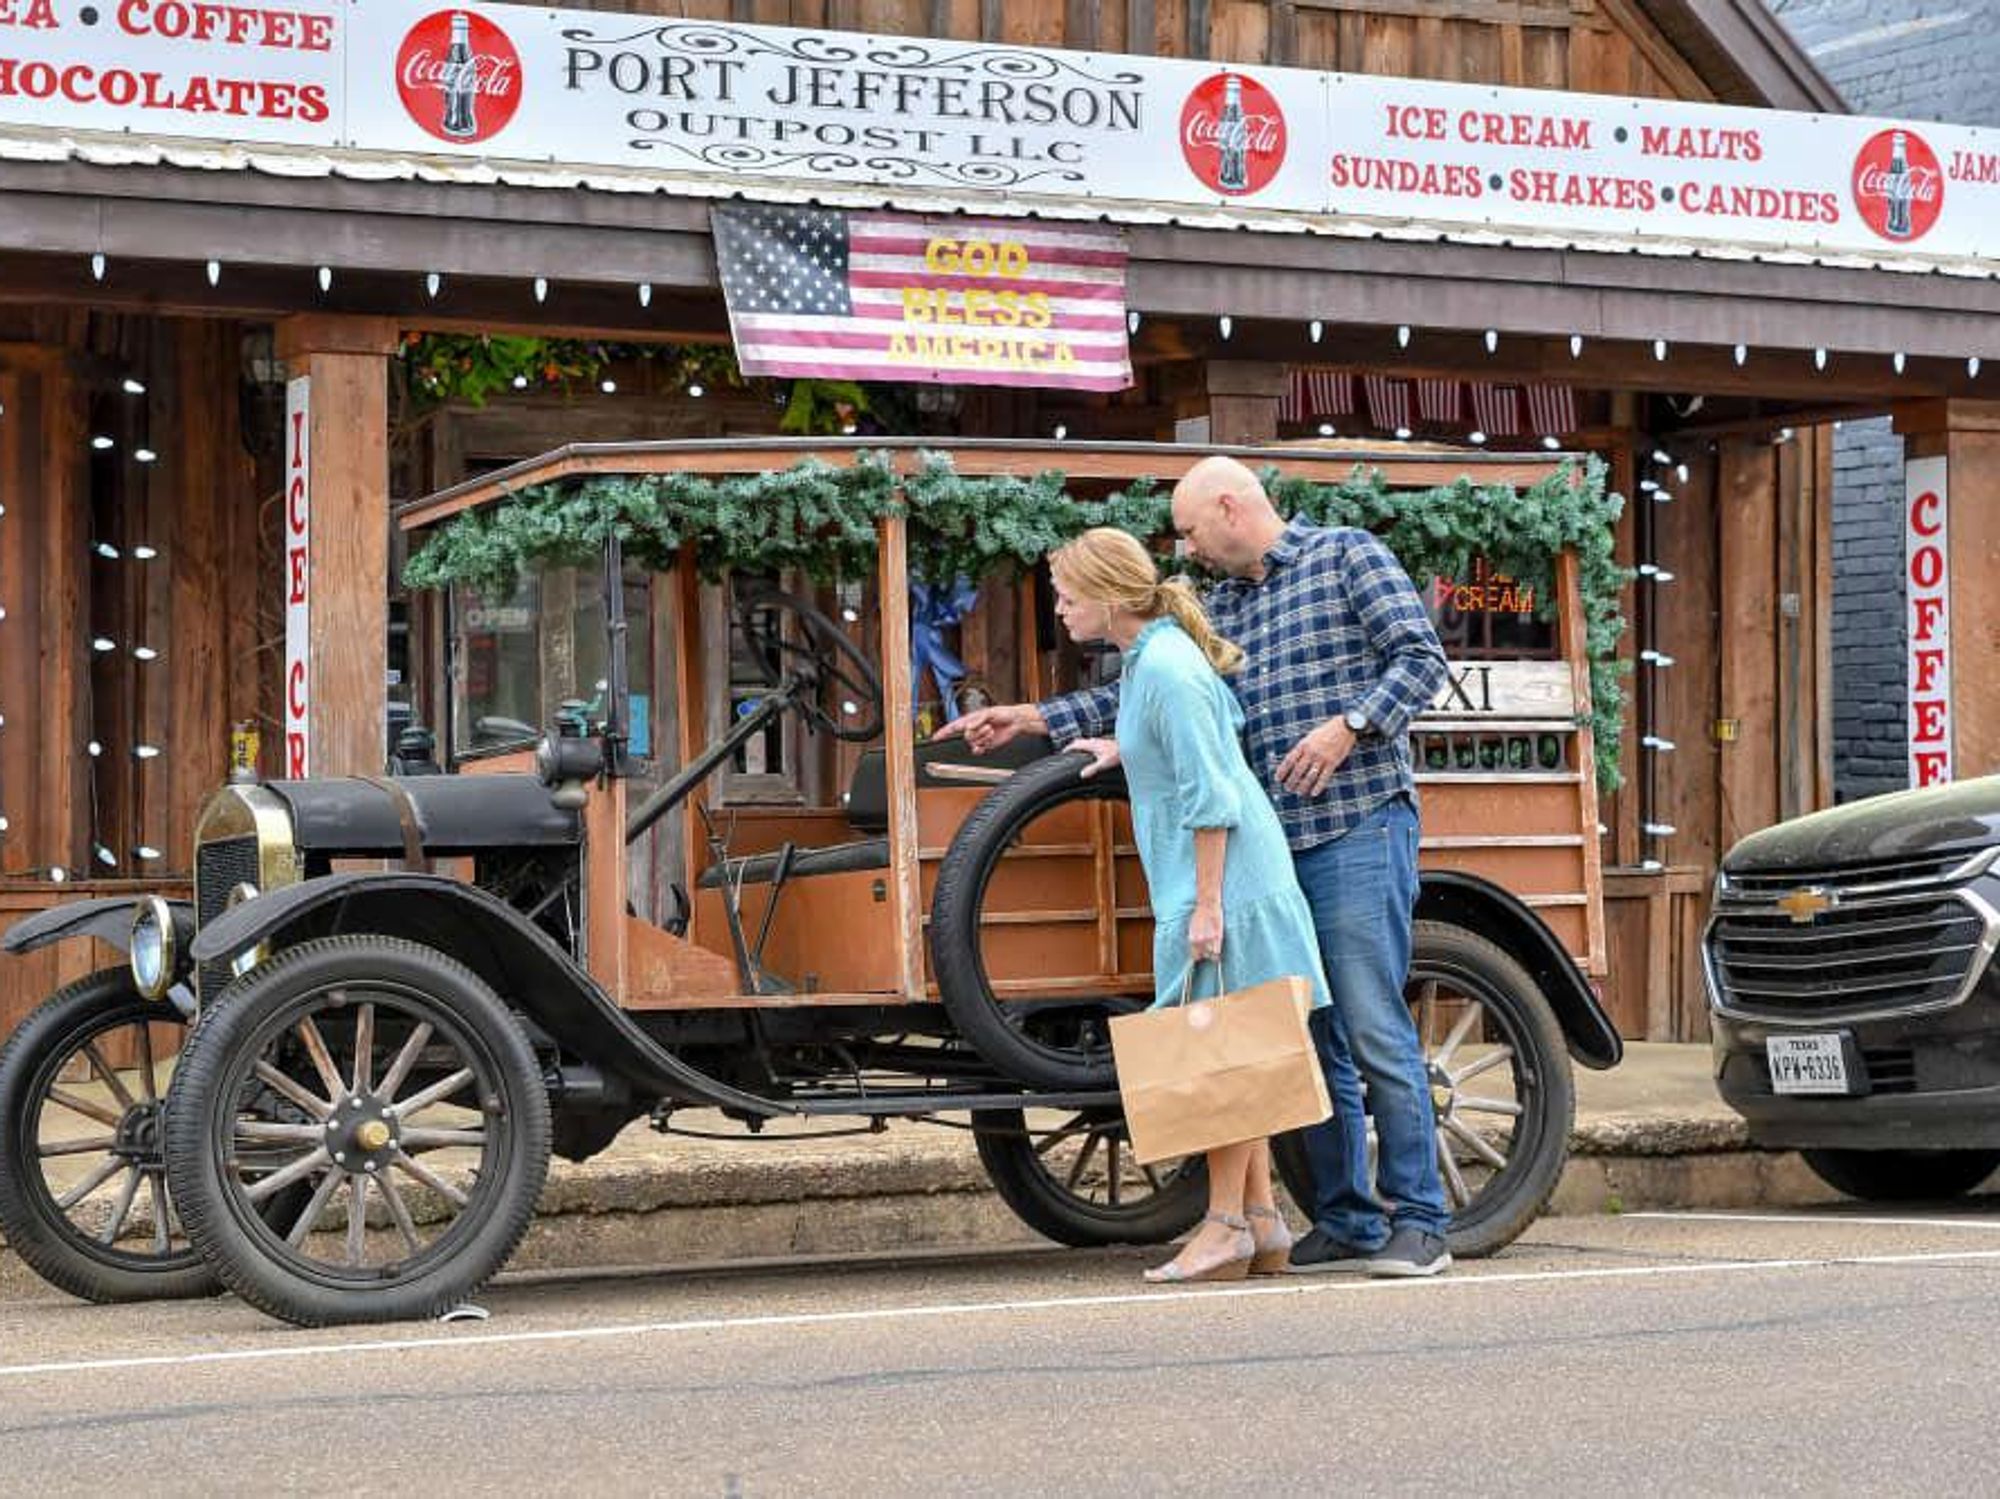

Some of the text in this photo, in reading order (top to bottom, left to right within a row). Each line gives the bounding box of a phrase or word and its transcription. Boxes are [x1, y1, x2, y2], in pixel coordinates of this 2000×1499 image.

[117, 0, 333, 51] COFFEE
[565, 47, 1143, 131] PORT JEFFERSON
[626, 108, 1085, 163] OUTPOST LLC
[1386, 104, 1764, 162] ICE CREAM MALTS
[1331, 154, 1841, 225] SUNDAES SHAKES CANDIES
[1948, 150, 2000, 183] JAM
[925, 238, 1030, 279] GOD
[902, 286, 1054, 329] BLESS
[886, 332, 1077, 368] AMERICA
[288, 412, 306, 604] ICE
[1454, 585, 1535, 613] CREAM
[1910, 491, 1947, 789] COFFEE
[1426, 666, 1495, 712] XI
[1789, 1040, 1820, 1051] TEXAS
